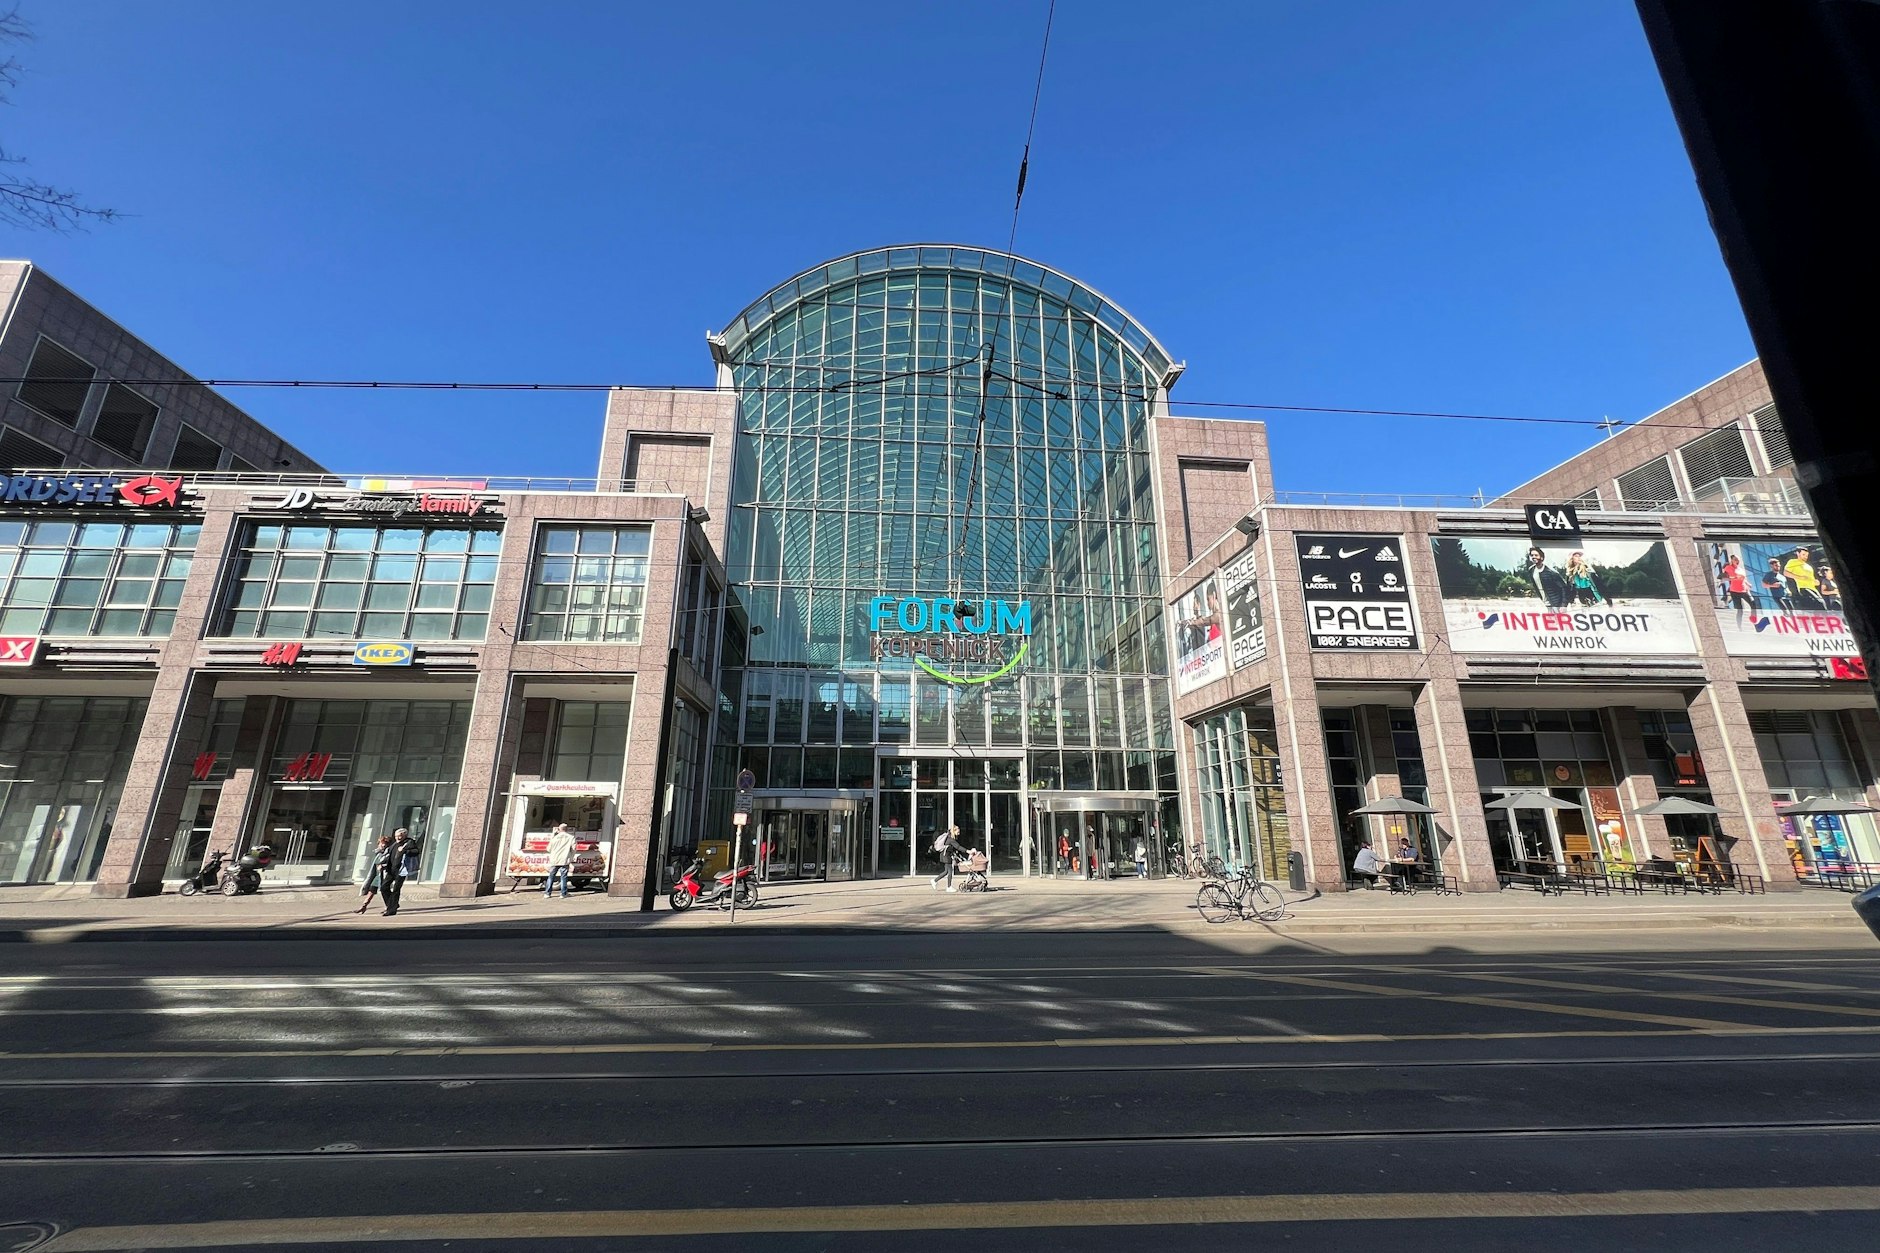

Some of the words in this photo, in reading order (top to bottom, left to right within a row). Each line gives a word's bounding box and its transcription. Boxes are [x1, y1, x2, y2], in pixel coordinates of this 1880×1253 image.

[276, 487, 313, 509] JD
[419, 492, 482, 516] family
[1534, 510, 1573, 530] C&A
[1225, 555, 1254, 587] PACE
[1304, 582, 1337, 590] LACOSTE
[870, 597, 1032, 635] FORUM
[1313, 605, 1406, 630] PACE
[1501, 611, 1649, 631] INTERSPORT
[1234, 631, 1264, 659] PACE
[1317, 636, 1342, 646] 100%
[1345, 636, 1409, 647] SNEAKERS
[1532, 636, 1607, 649] WAWROK
[260, 642, 303, 665] H&M
[360, 648, 406, 658] IKEA
[1184, 646, 1222, 676] INTERSPORT
